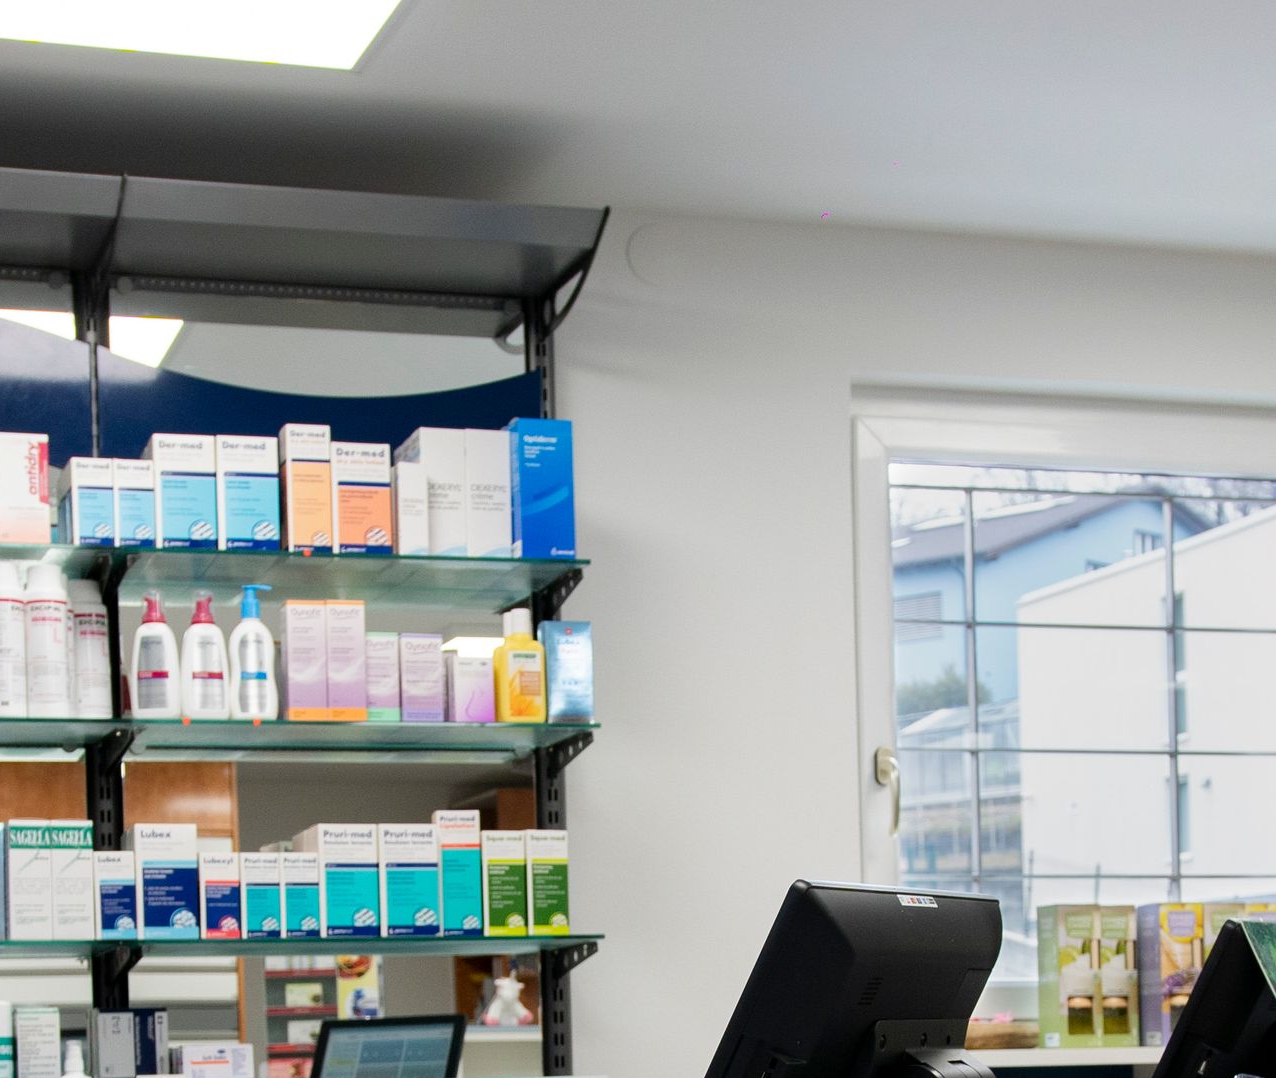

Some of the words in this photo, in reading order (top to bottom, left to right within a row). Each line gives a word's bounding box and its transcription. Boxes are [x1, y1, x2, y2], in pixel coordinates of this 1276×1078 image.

[158, 440, 203, 450] Der-med
[222, 441, 266, 451] Der-med
[336, 448, 386, 458] Der-med
[27, 440, 39, 496] antidry
[9, 832, 52, 847] SAGELLA
[51, 832, 93, 847] SAGELLA
[140, 830, 172, 840] Lubex
[323, 830, 373, 839] Pruri-med
[383, 830, 434, 839] Pruri-med
